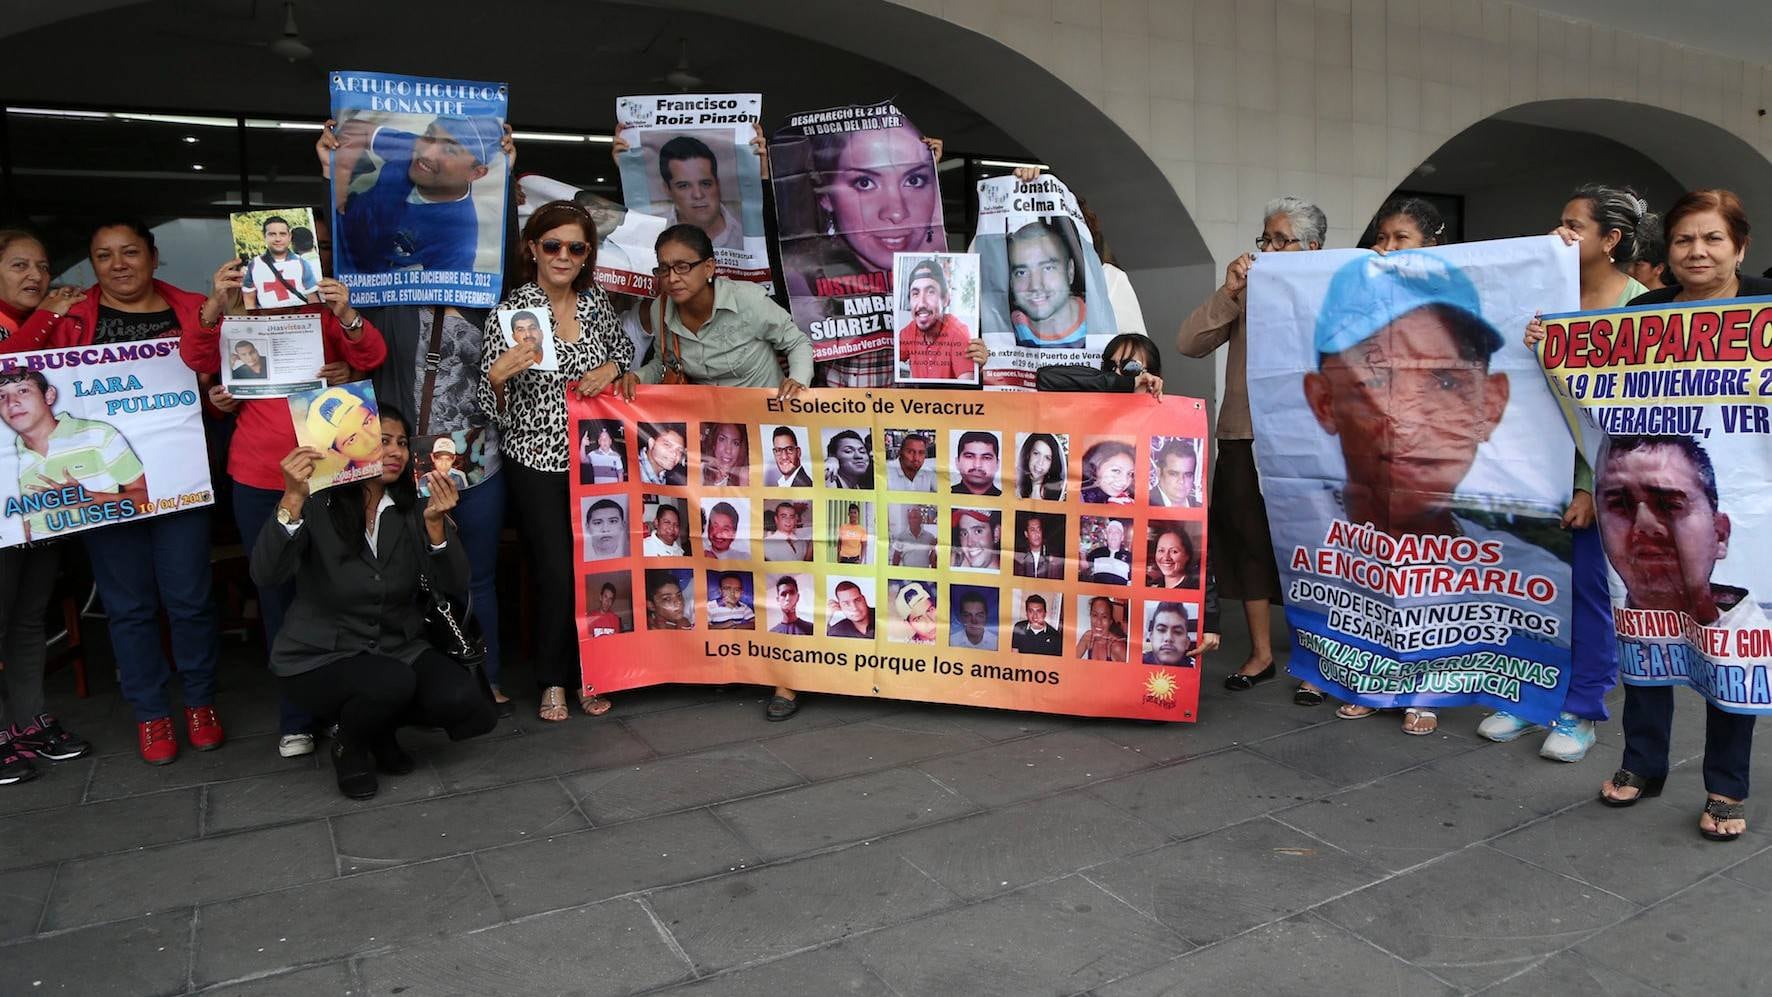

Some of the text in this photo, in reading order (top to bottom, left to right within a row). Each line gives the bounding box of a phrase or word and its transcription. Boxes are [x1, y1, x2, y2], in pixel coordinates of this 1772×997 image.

[335, 77, 505, 101] ARTURO FIGUEROA
[371, 96, 465, 115] BONASTRE
[656, 98, 738, 111] Francisco
[855, 108, 865, 116] EL
[867, 107, 874, 115] 2
[875, 106, 888, 115] DE
[656, 113, 694, 125] Roiz
[699, 111, 758, 125] Pinzón
[803, 126, 815, 136] EN
[816, 123, 843, 135] BOCA
[843, 120, 861, 132] DEL
[881, 116, 902, 128] VER.
[1013, 198, 1055, 211] Celma
[339, 272, 491, 287] DESAPARECIDO EL 1 DE DICIEMBRE DEL 2012
[632, 275, 653, 290] 2013
[816, 272, 888, 297] JUSTICIA
[350, 293, 381, 305] CARDEL,
[382, 291, 398, 302] VER.
[399, 290, 443, 302] ESTUDIANTE
[444, 290, 454, 302] DE
[810, 316, 881, 340] SÚAREZ
[1543, 308, 1772, 370] DESAPAREC
[1070, 352, 1080, 360] de
[73, 374, 143, 397] LARA
[1566, 374, 1589, 400] 19
[1592, 373, 1618, 399] DE
[1622, 368, 1752, 398] NOVIEMBRE
[105, 390, 196, 416] PULIDO
[767, 397, 985, 415] El Solecito de Veracruz
[1599, 405, 1711, 438] VERACRUZ,
[1721, 405, 1769, 433] VER
[5, 485, 93, 518] ANGEL
[46, 499, 136, 531] ULISES
[1326, 521, 1502, 565] AYÚDANOS
[1291, 547, 1555, 603] A ENCONTRARLO
[1291, 581, 1361, 613] ¿DONDE
[1365, 599, 1422, 628] ESTAN
[1427, 604, 1558, 635] NUESTROS
[1329, 610, 1509, 650] DESAPARECIDOS?
[704, 640, 1060, 685] Los buscamos porque los amamos
[1297, 629, 1559, 688] FAMILIAS VERACRUZANAS
[1320, 660, 1520, 701] QUE PIDEN JUSTICIA
